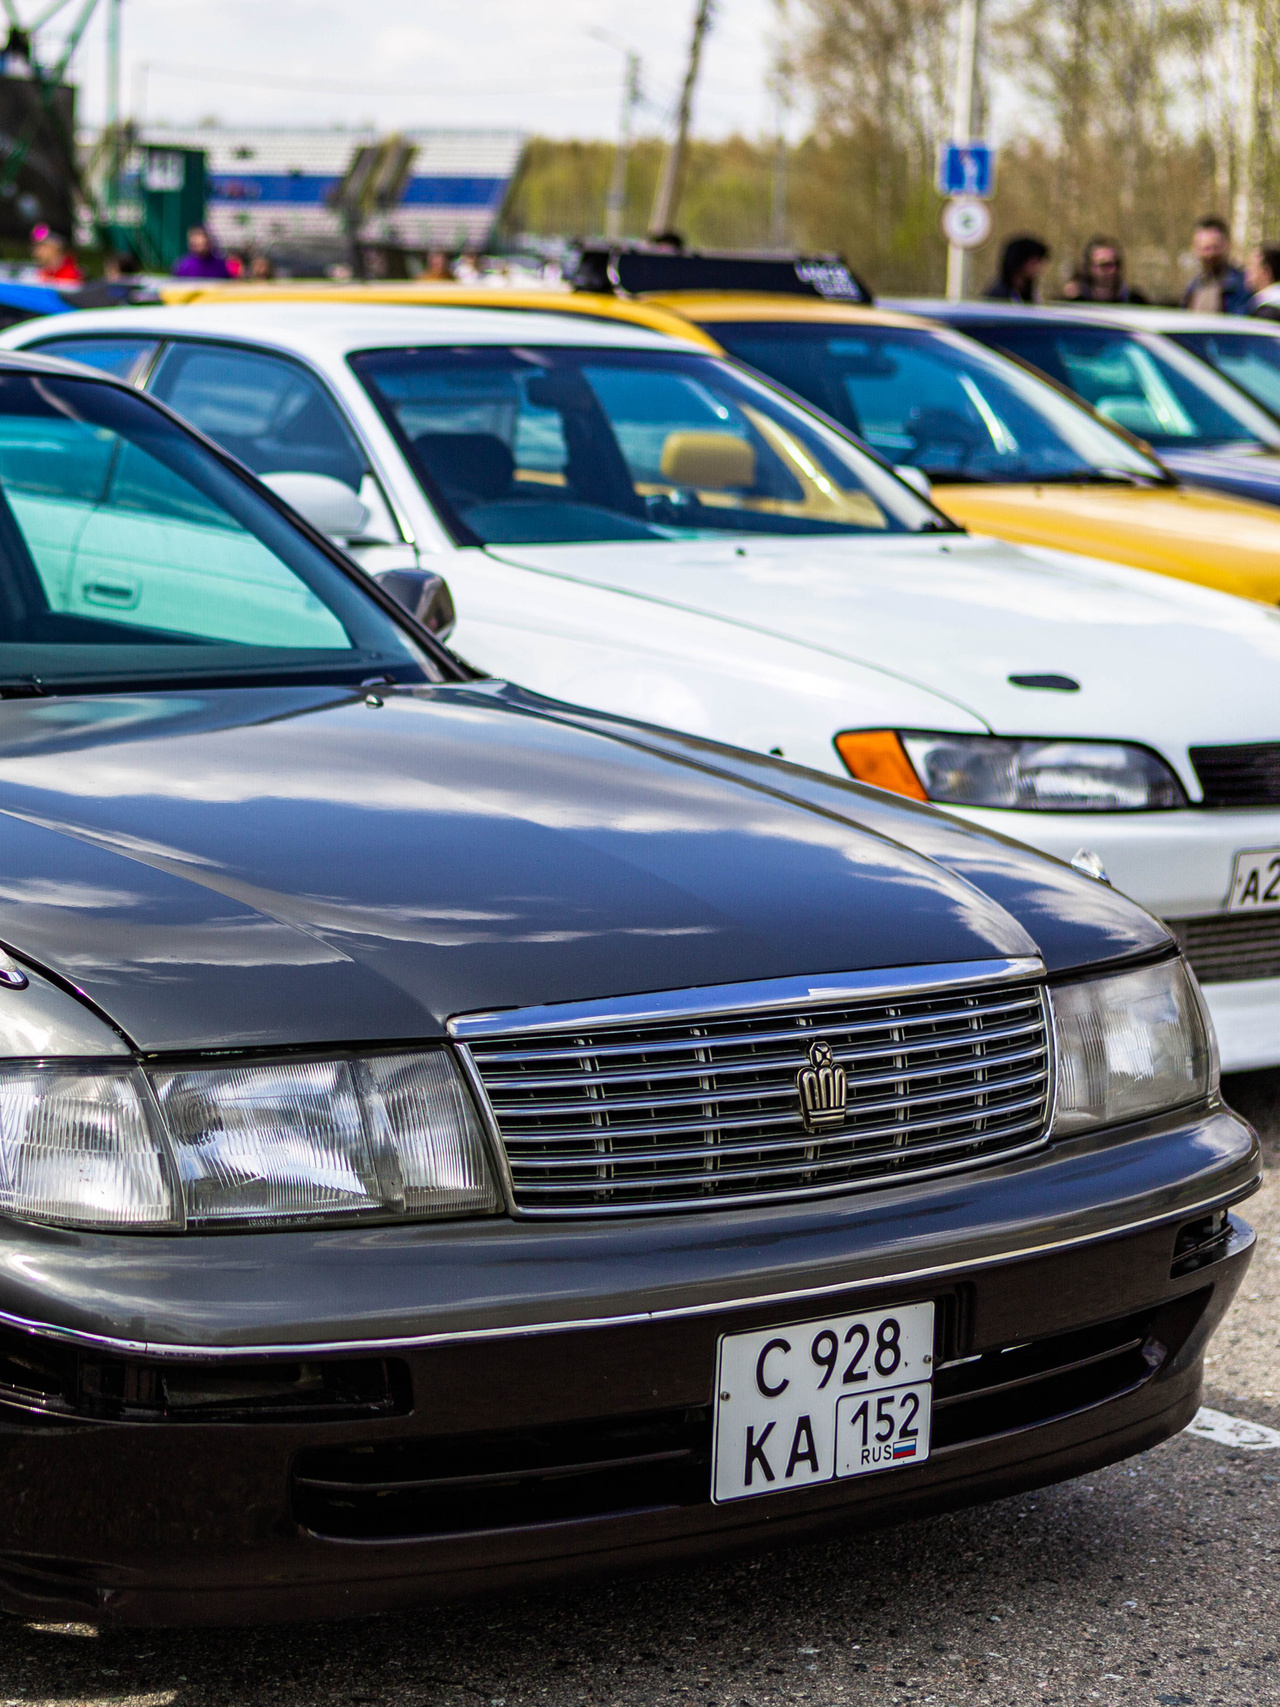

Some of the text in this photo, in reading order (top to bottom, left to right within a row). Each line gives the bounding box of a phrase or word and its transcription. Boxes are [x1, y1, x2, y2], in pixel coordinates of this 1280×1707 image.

[756, 1317, 902, 1398] C 928
[744, 1414, 820, 1487] KA
[850, 1392, 920, 1447] 152
[861, 1444, 893, 1466] RUS
